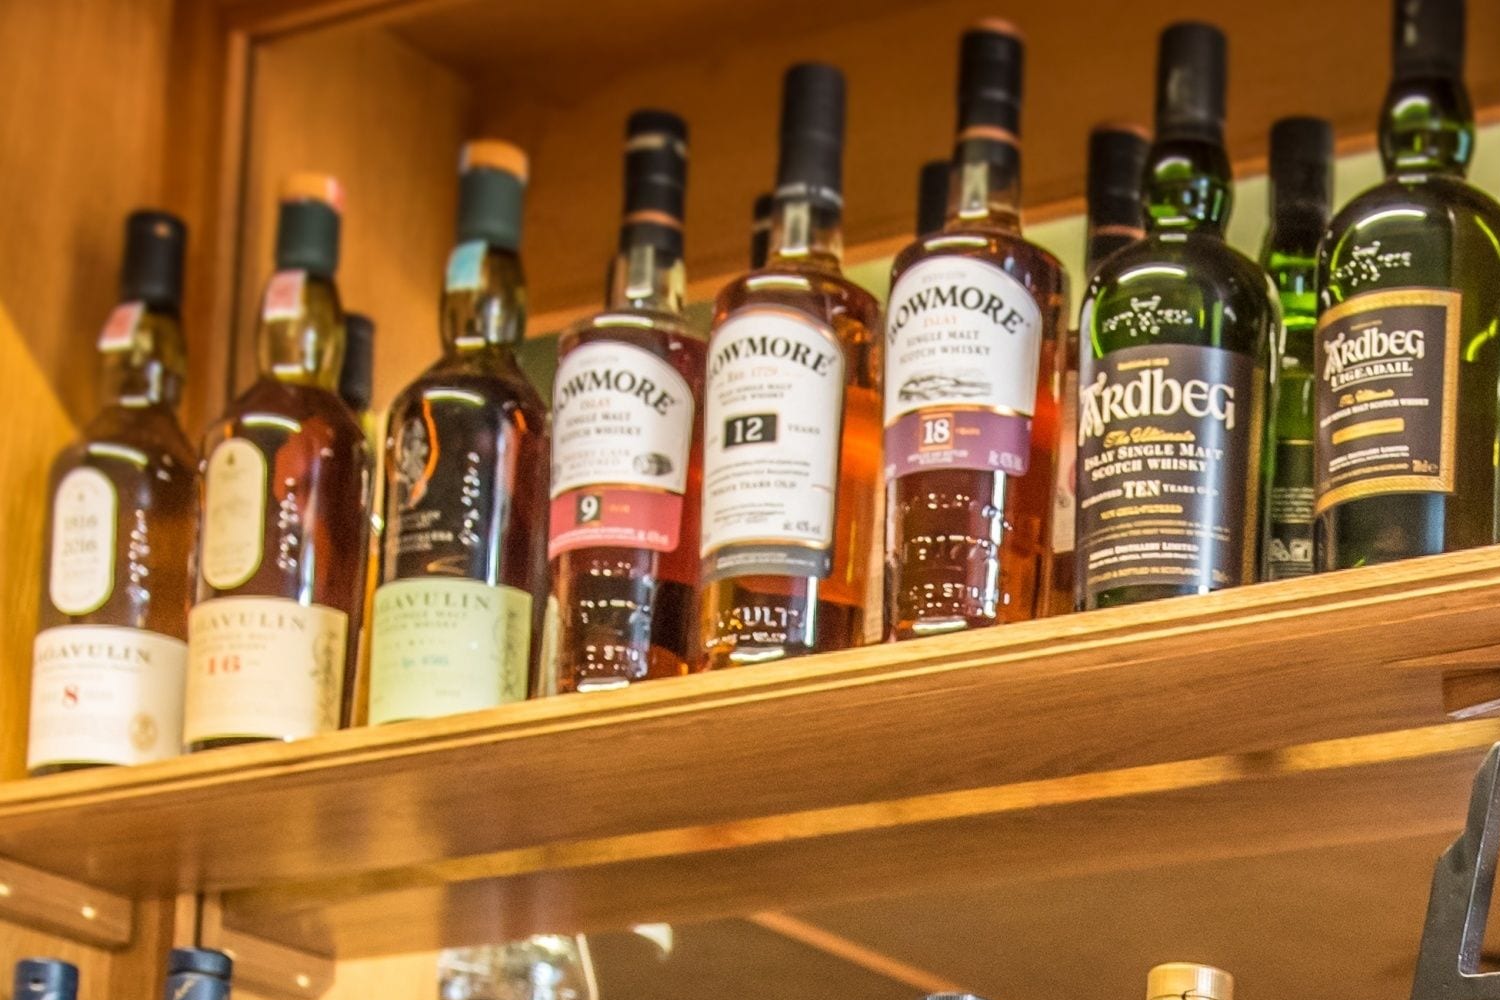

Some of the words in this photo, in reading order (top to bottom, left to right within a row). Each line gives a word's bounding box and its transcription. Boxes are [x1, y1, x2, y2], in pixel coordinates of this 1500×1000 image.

[949, 330, 980, 341] MALT
[707, 335, 829, 378] OWMORE
[940, 345, 991, 356] WHISKY
[556, 368, 676, 417] OWMORE
[734, 416, 764, 444] 12
[923, 418, 951, 445] 18
[1117, 443, 1175, 458] SINGLE
[1179, 442, 1224, 460] MALT
[1091, 458, 1142, 482] SCOTCH
[1147, 457, 1208, 473] WHISKY
[1122, 479, 1161, 499] TEN
[580, 494, 599, 523] 9
[378, 592, 490, 611] AVULIN
[194, 610, 307, 630] AVULIN
[63, 684, 79, 708] 8
